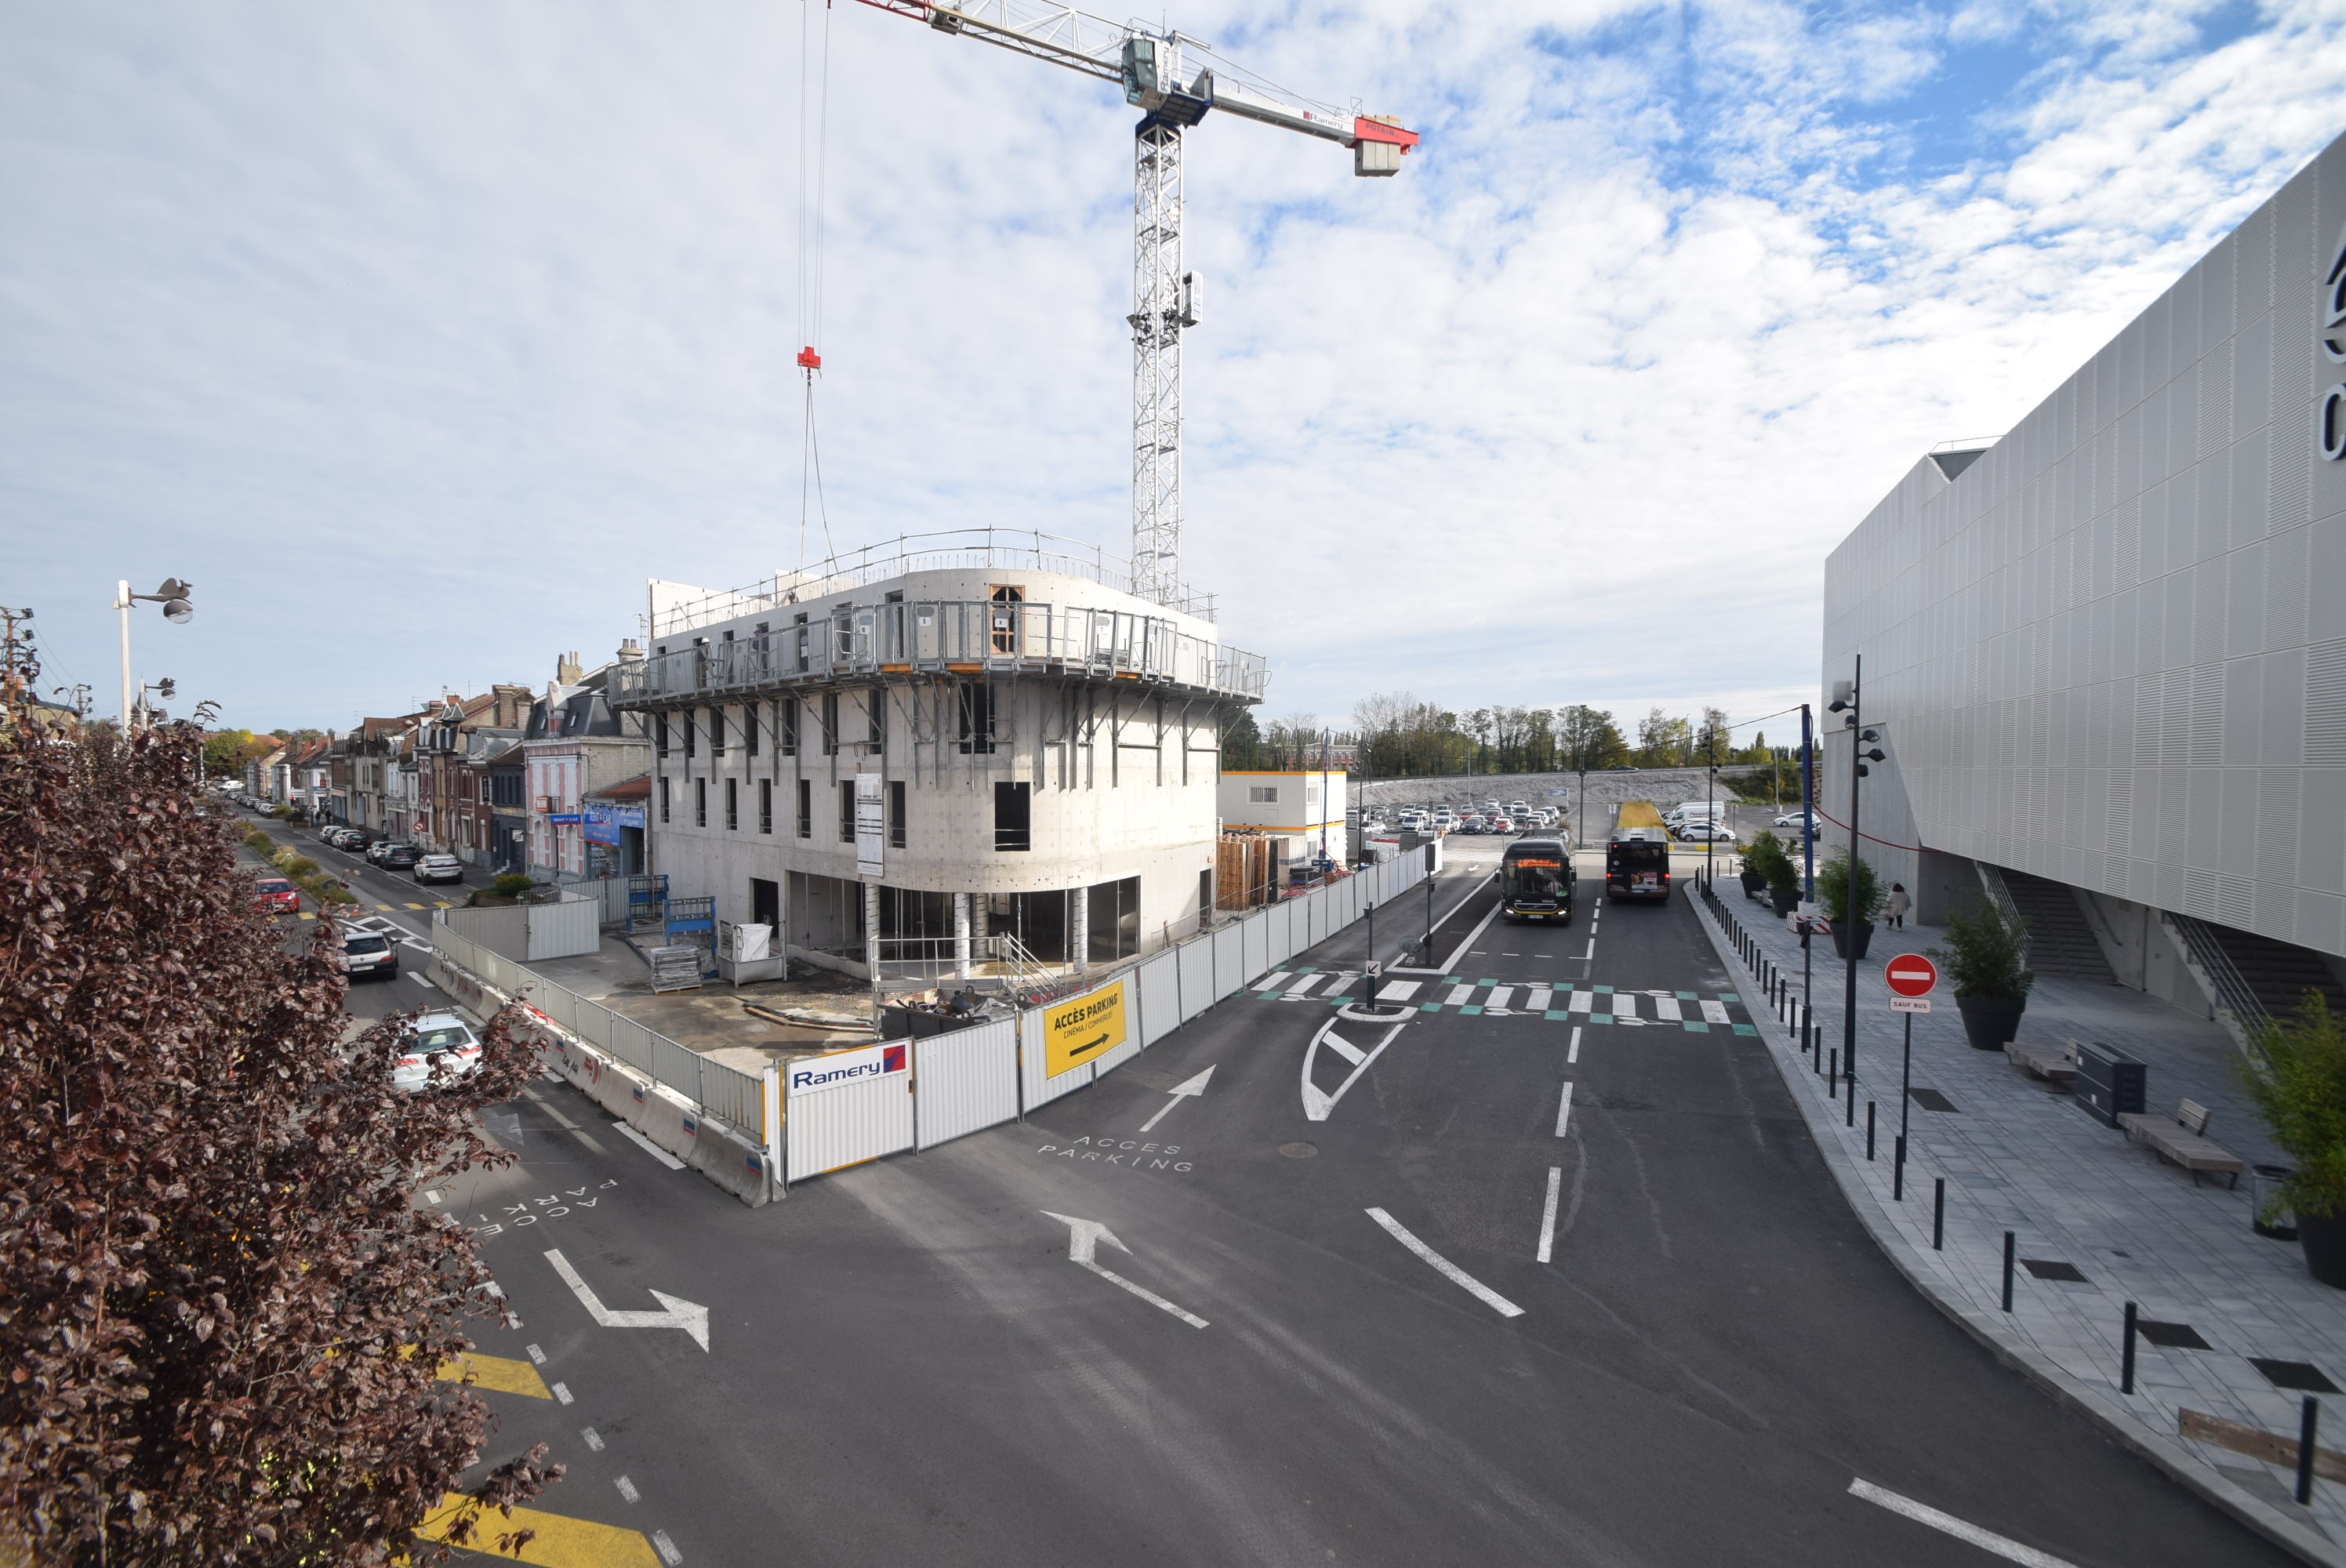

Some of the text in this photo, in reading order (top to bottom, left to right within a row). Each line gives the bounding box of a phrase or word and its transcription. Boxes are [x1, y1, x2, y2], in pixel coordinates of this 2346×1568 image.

[1160, 47, 1169, 92] Ramery
[1310, 114, 1343, 129] Ramery
[1365, 122, 1395, 137] POTAIN
[1054, 993, 1118, 1031] ACCÈS PARKING
[1088, 1011, 1113, 1029] COMMERCES
[794, 1062, 880, 1089] Ramery
[1037, 1145, 1193, 1172] PARKING
[1073, 1136, 1181, 1155] ACCES
[479, 1179, 619, 1221] PARKI
[480, 1197, 597, 1236] ACCE
